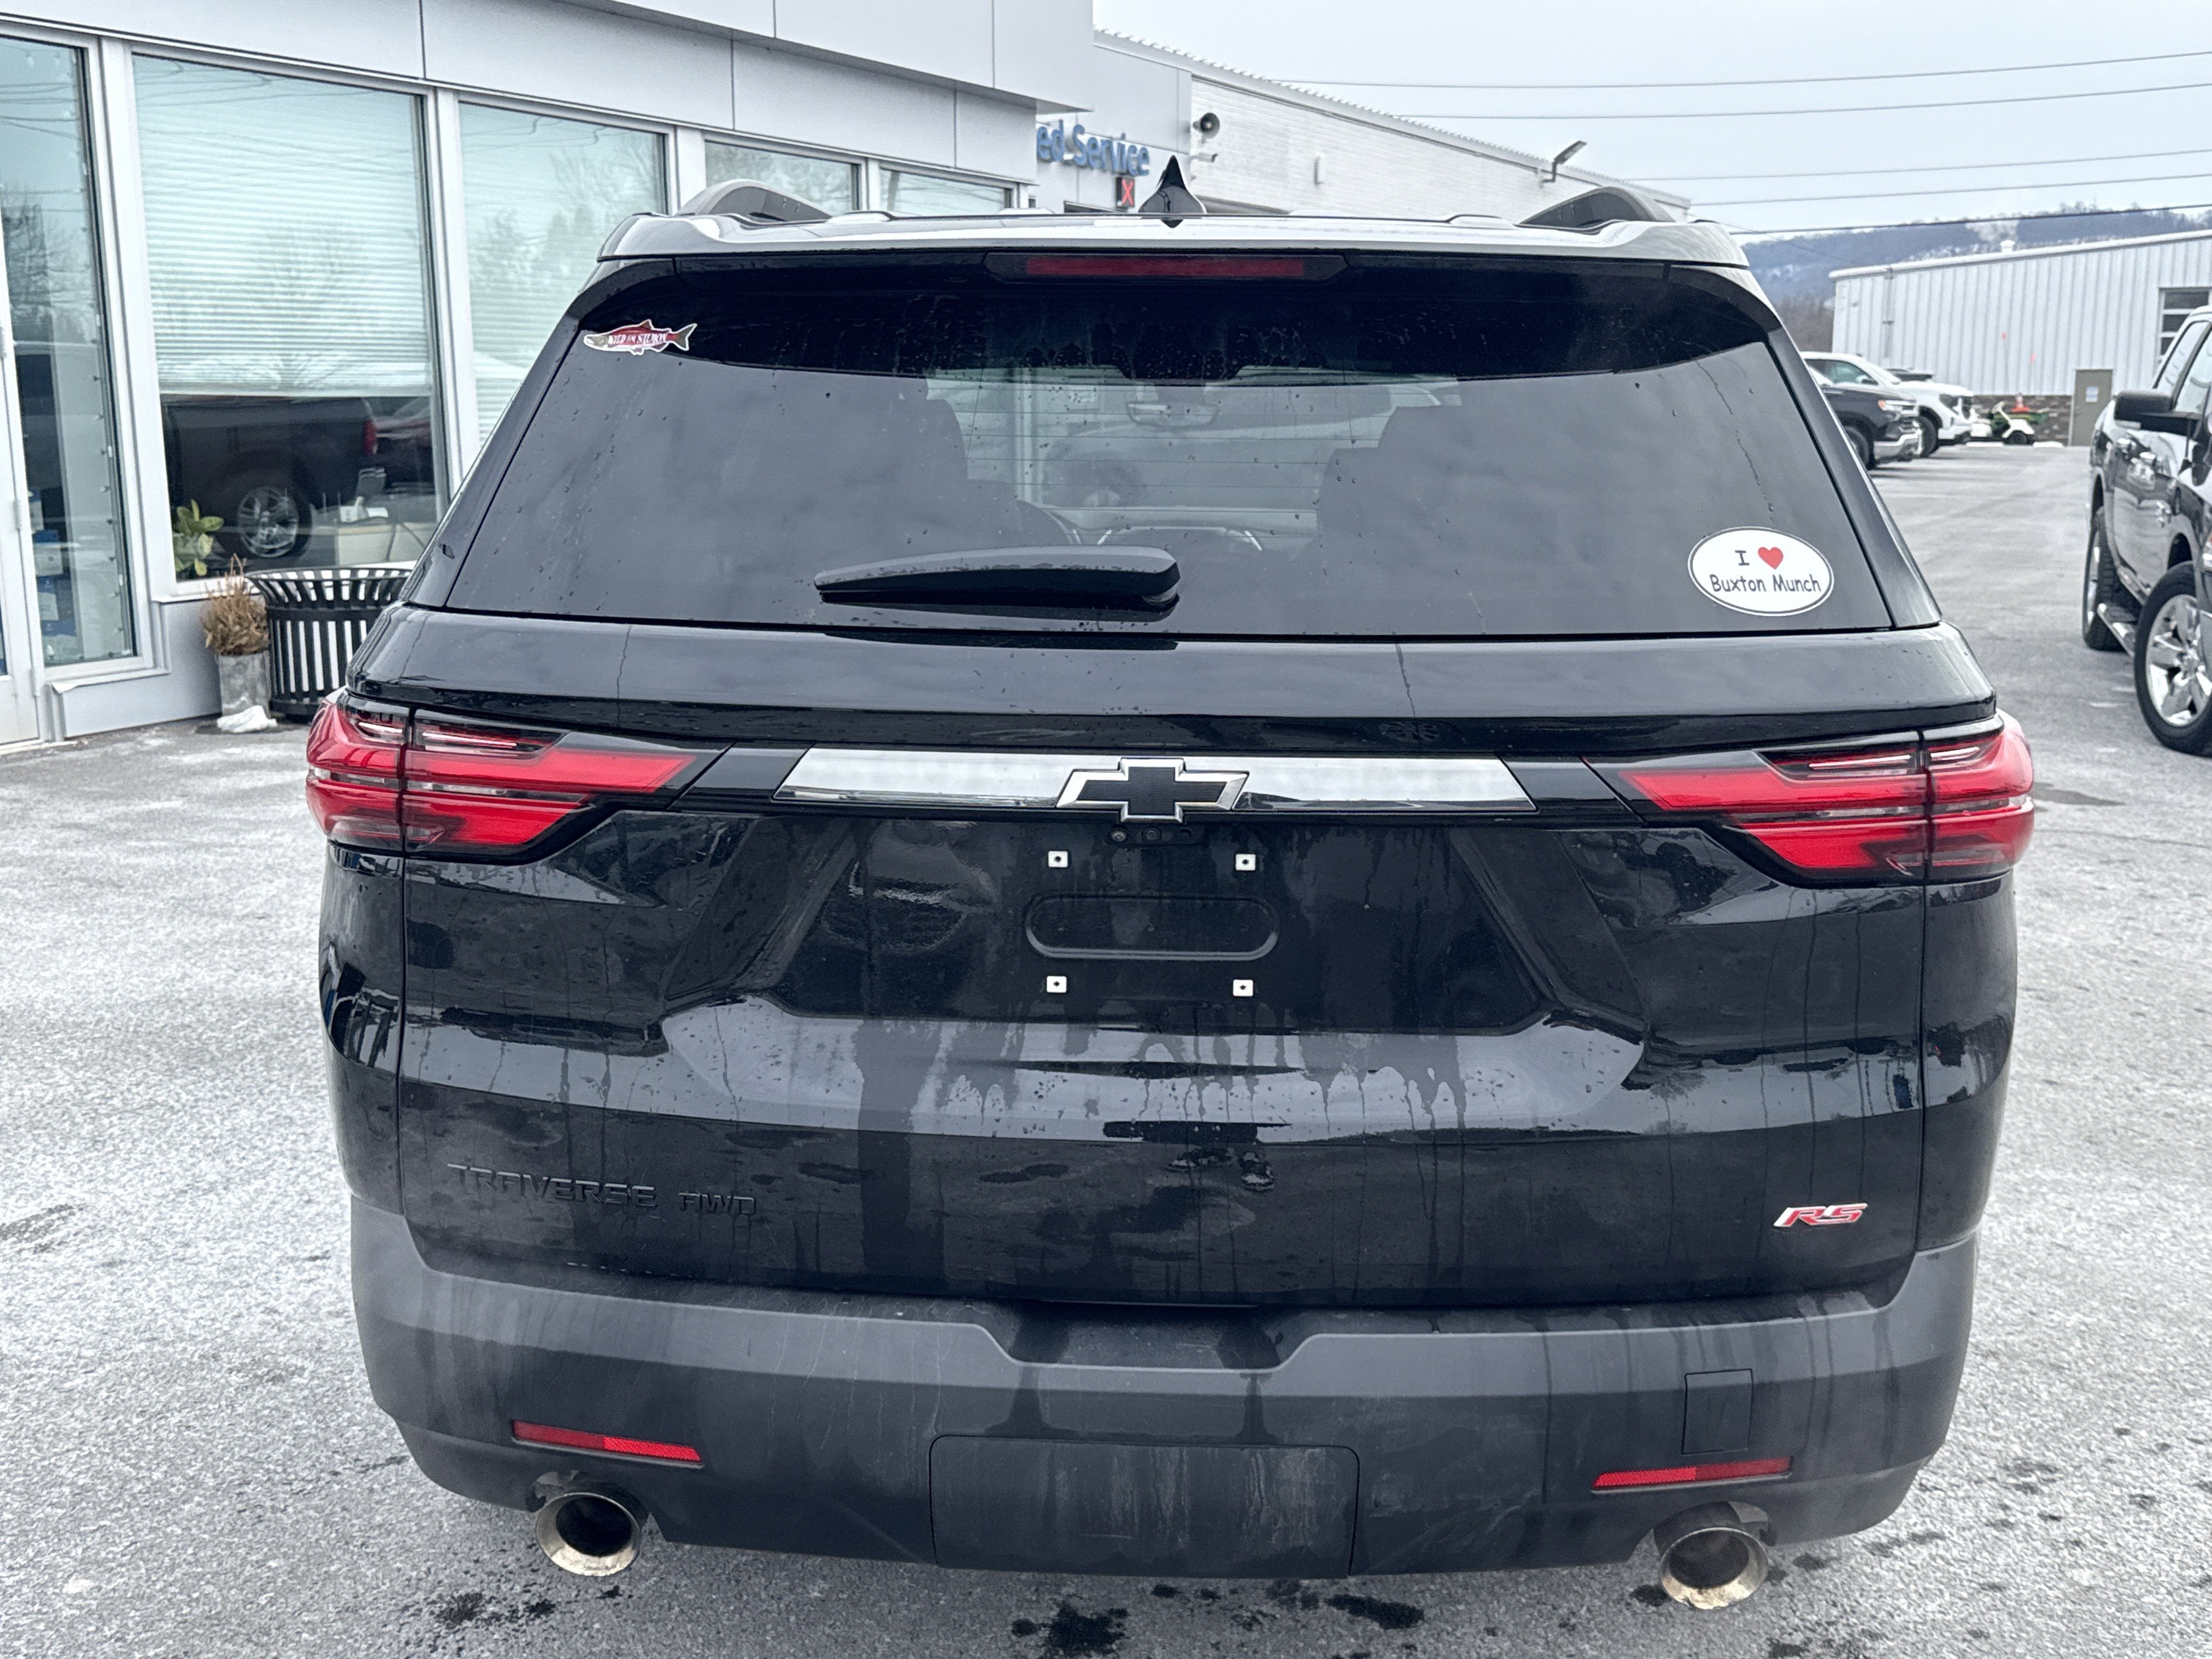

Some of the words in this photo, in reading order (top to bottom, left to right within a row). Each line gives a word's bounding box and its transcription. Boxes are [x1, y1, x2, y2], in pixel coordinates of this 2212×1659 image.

[1037, 119, 1064, 163] ed
[1072, 124, 1150, 177] Service
[1734, 550, 1750, 566] I
[1709, 574, 1767, 592] Buxton
[1772, 574, 1821, 592] Munch
[447, 1162, 658, 1209] TRAVERSE
[1773, 1202, 1869, 1228] RS
